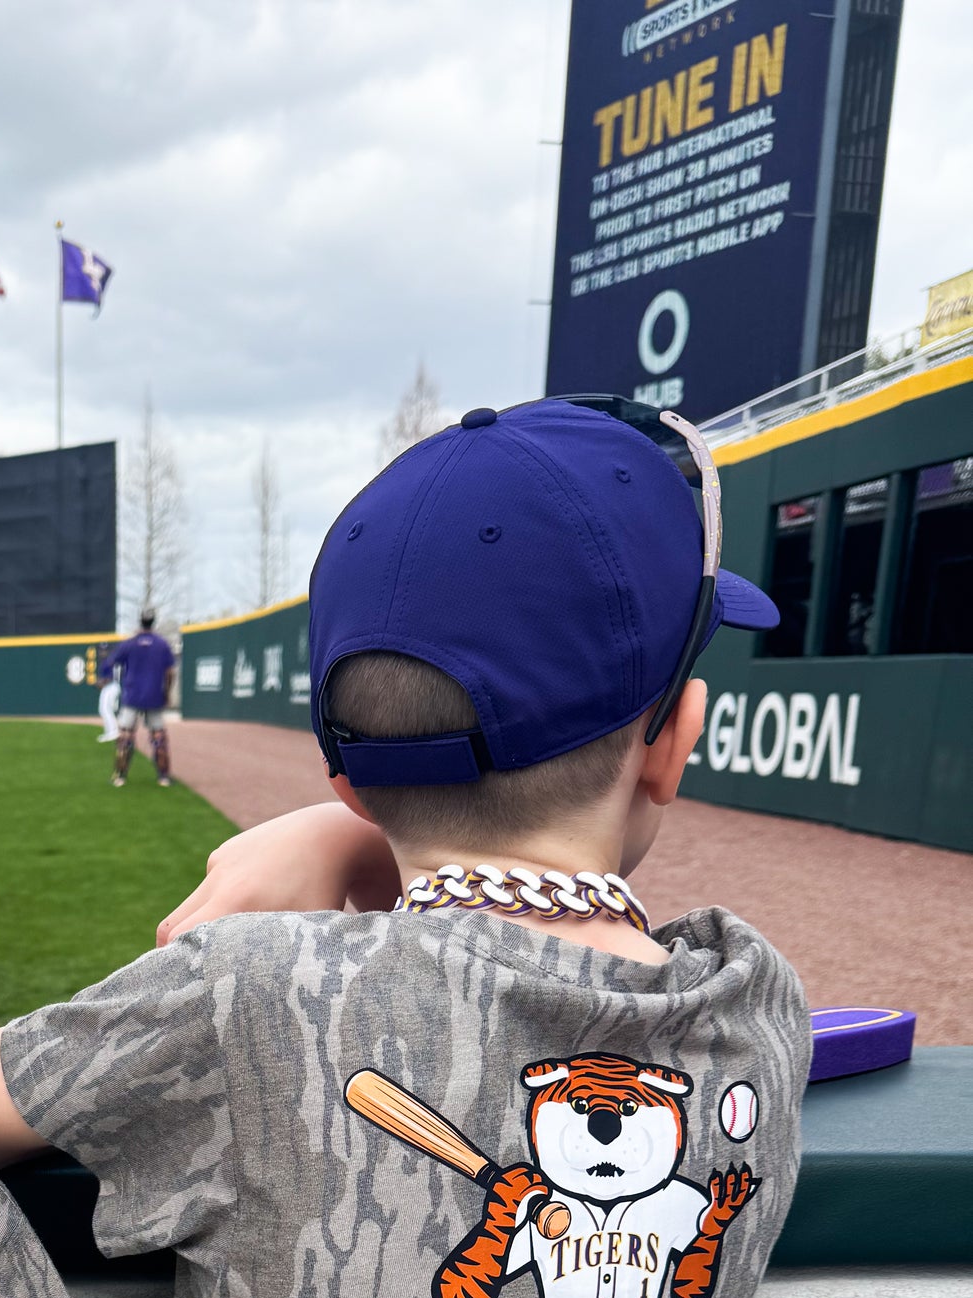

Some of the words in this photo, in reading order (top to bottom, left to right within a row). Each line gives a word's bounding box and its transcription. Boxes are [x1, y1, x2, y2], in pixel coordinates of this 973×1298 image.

[593, 56, 719, 168] TUNE
[728, 23, 788, 113] IN
[592, 171, 610, 194] TO
[610, 161, 637, 187] THE
[636, 150, 664, 177] HUB
[665, 105, 776, 165] INTERNATIONAL
[645, 167, 685, 199] SHOW
[707, 133, 774, 175] MINUTES
[570, 249, 594, 274] THE
[621, 223, 673, 257] SPORTS
[717, 180, 791, 224] NETWORK
[595, 212, 634, 242] PRIOR
[635, 204, 652, 227] TO
[653, 190, 693, 220] FIRST
[694, 173, 738, 205] PITCH
[739, 164, 762, 189] ON
[589, 268, 614, 291] THE
[641, 241, 695, 274] SPORTS
[696, 222, 751, 257] MOBILE
[751, 211, 785, 238] APP
[707, 691, 861, 786] GLOBAL
[550, 1231, 659, 1283] TIGERS
